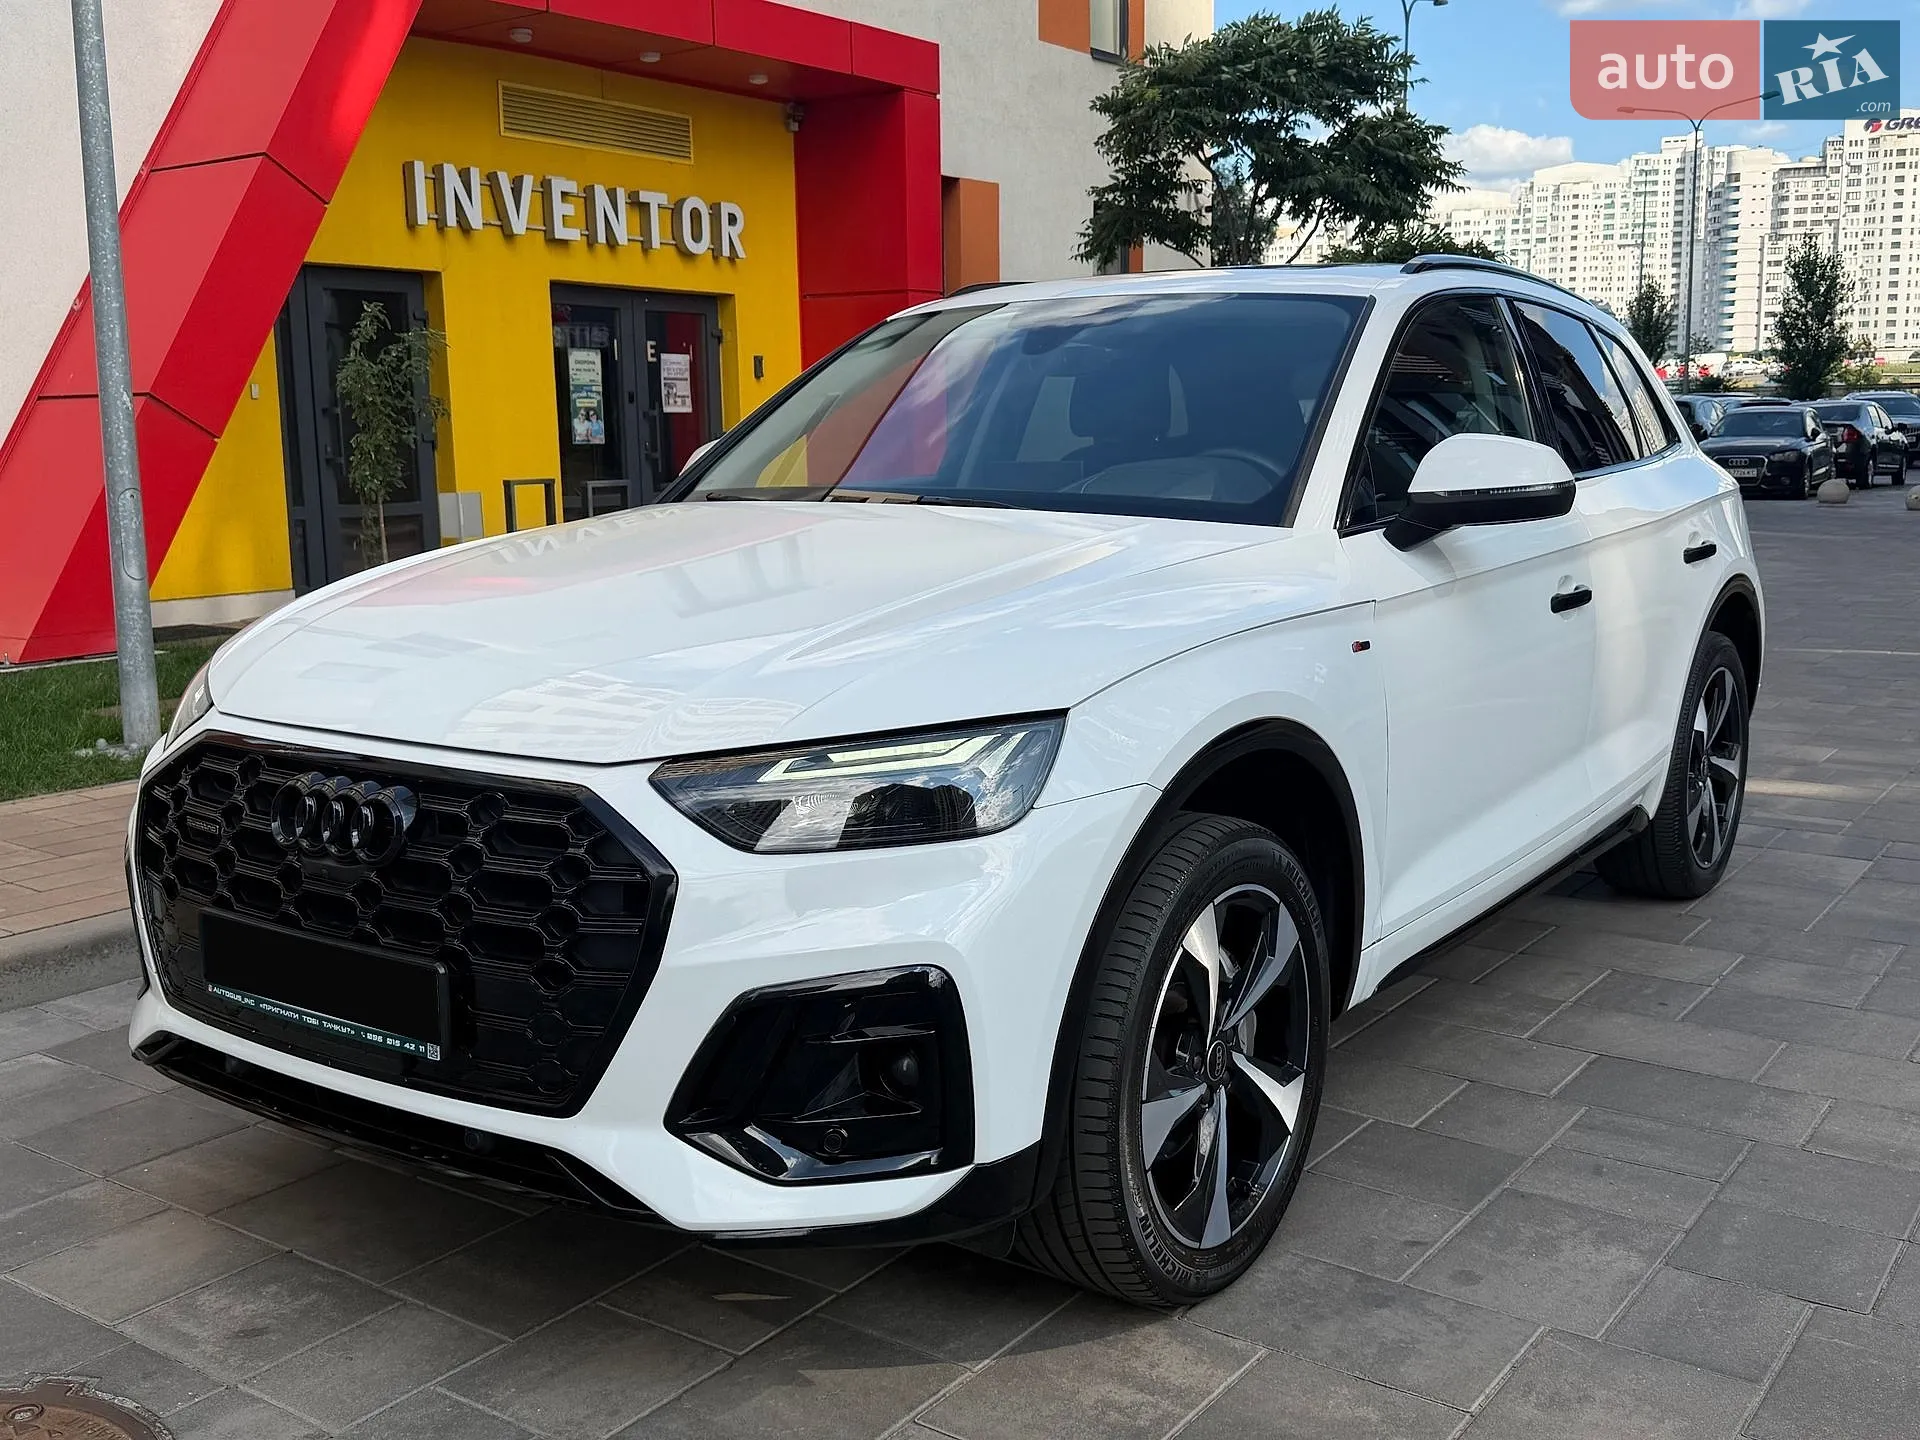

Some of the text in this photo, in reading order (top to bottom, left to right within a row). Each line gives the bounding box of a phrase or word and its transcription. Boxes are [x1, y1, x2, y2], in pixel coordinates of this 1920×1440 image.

[404, 160, 747, 260] INVENTOR
[403, 1042, 416, 1051] 42
[1137, 1214, 1193, 1284] MICHELIN
